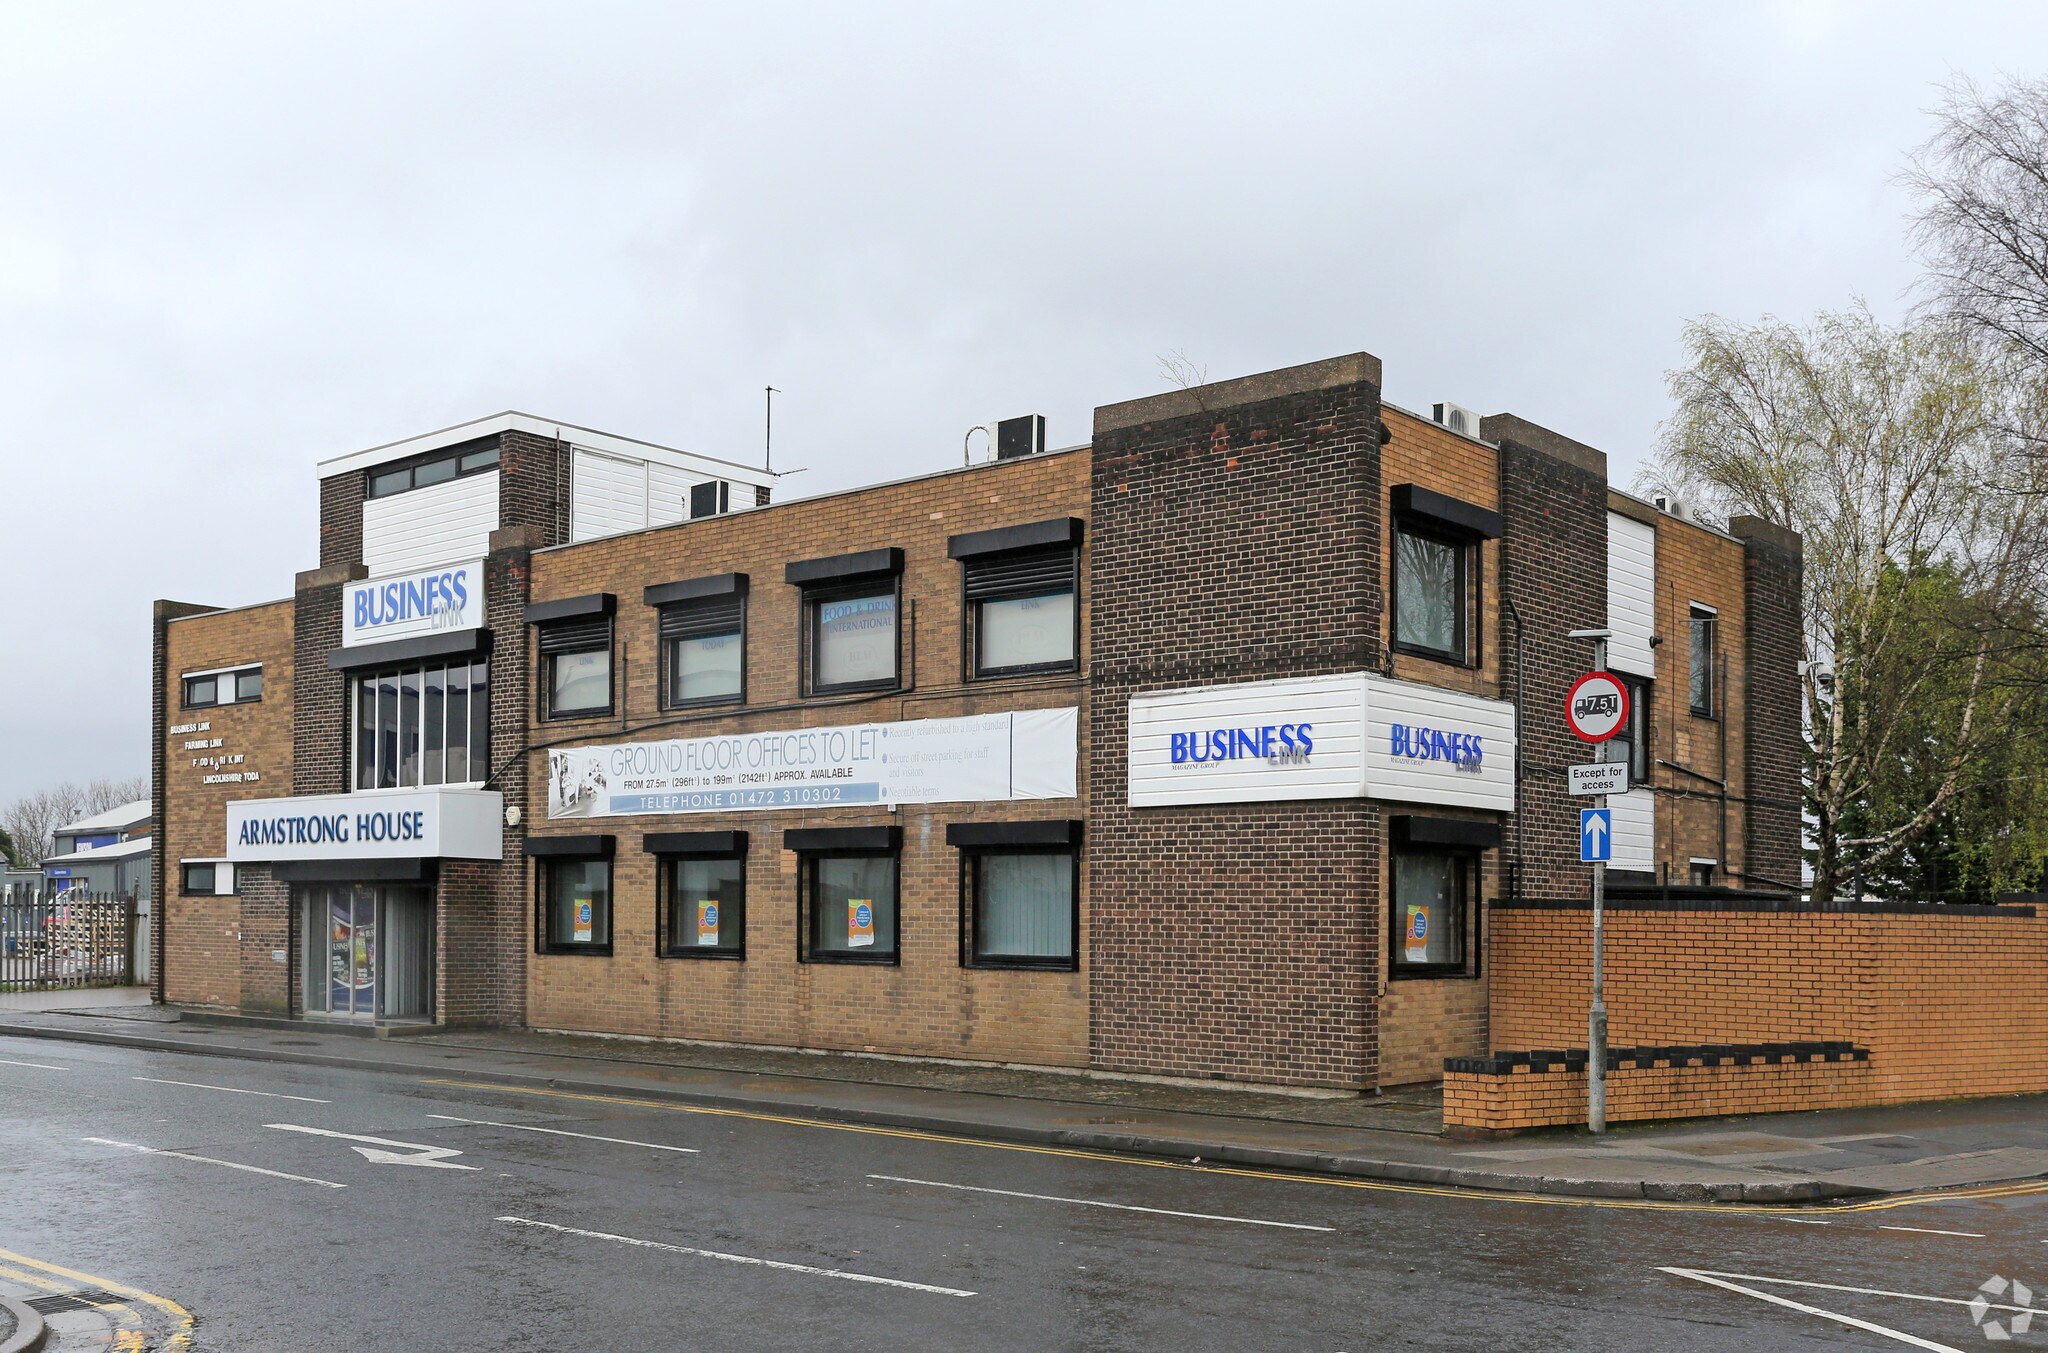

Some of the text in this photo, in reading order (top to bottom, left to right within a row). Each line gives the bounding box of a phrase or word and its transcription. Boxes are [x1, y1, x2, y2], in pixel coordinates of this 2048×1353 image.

[354, 569, 467, 628] BUSINESS
[1021, 599, 1040, 610] LINK
[431, 600, 464, 630] LINK
[824, 605, 852, 620] FOOD
[829, 617, 892, 632] INTERNATIONAL
[170, 722, 211, 734] BUSINESS LINK
[889, 726, 915, 740] Recently
[916, 722, 951, 736] refurbished
[981, 716, 1009, 731] standard
[185, 738, 223, 750] FARMING LINK
[610, 728, 879, 776] GROUND FLOOR OFFICES TO LET
[1171, 723, 1313, 763] BUSINESS
[1391, 723, 1482, 764] BUSINESS
[889, 752, 910, 764] Secure
[920, 750, 937, 761] street
[938, 748, 963, 764] parking
[964, 748, 973, 759] for
[974, 746, 989, 758] staff
[1267, 744, 1311, 765] LINK
[203, 773, 242, 784] LINCOLNSHIRE
[624, 780, 644, 790] FROM
[703, 776, 710, 785] to
[774, 769, 807, 781] APPROX.
[810, 767, 853, 779] AVAILABLE
[1573, 767, 1623, 779] Except for
[889, 785, 940, 799] Negotiable terms
[1581, 781, 1614, 790] access
[640, 787, 841, 809] TELEPHONE 01472 310302
[239, 810, 423, 846] ARMSTRONG HOUSE
